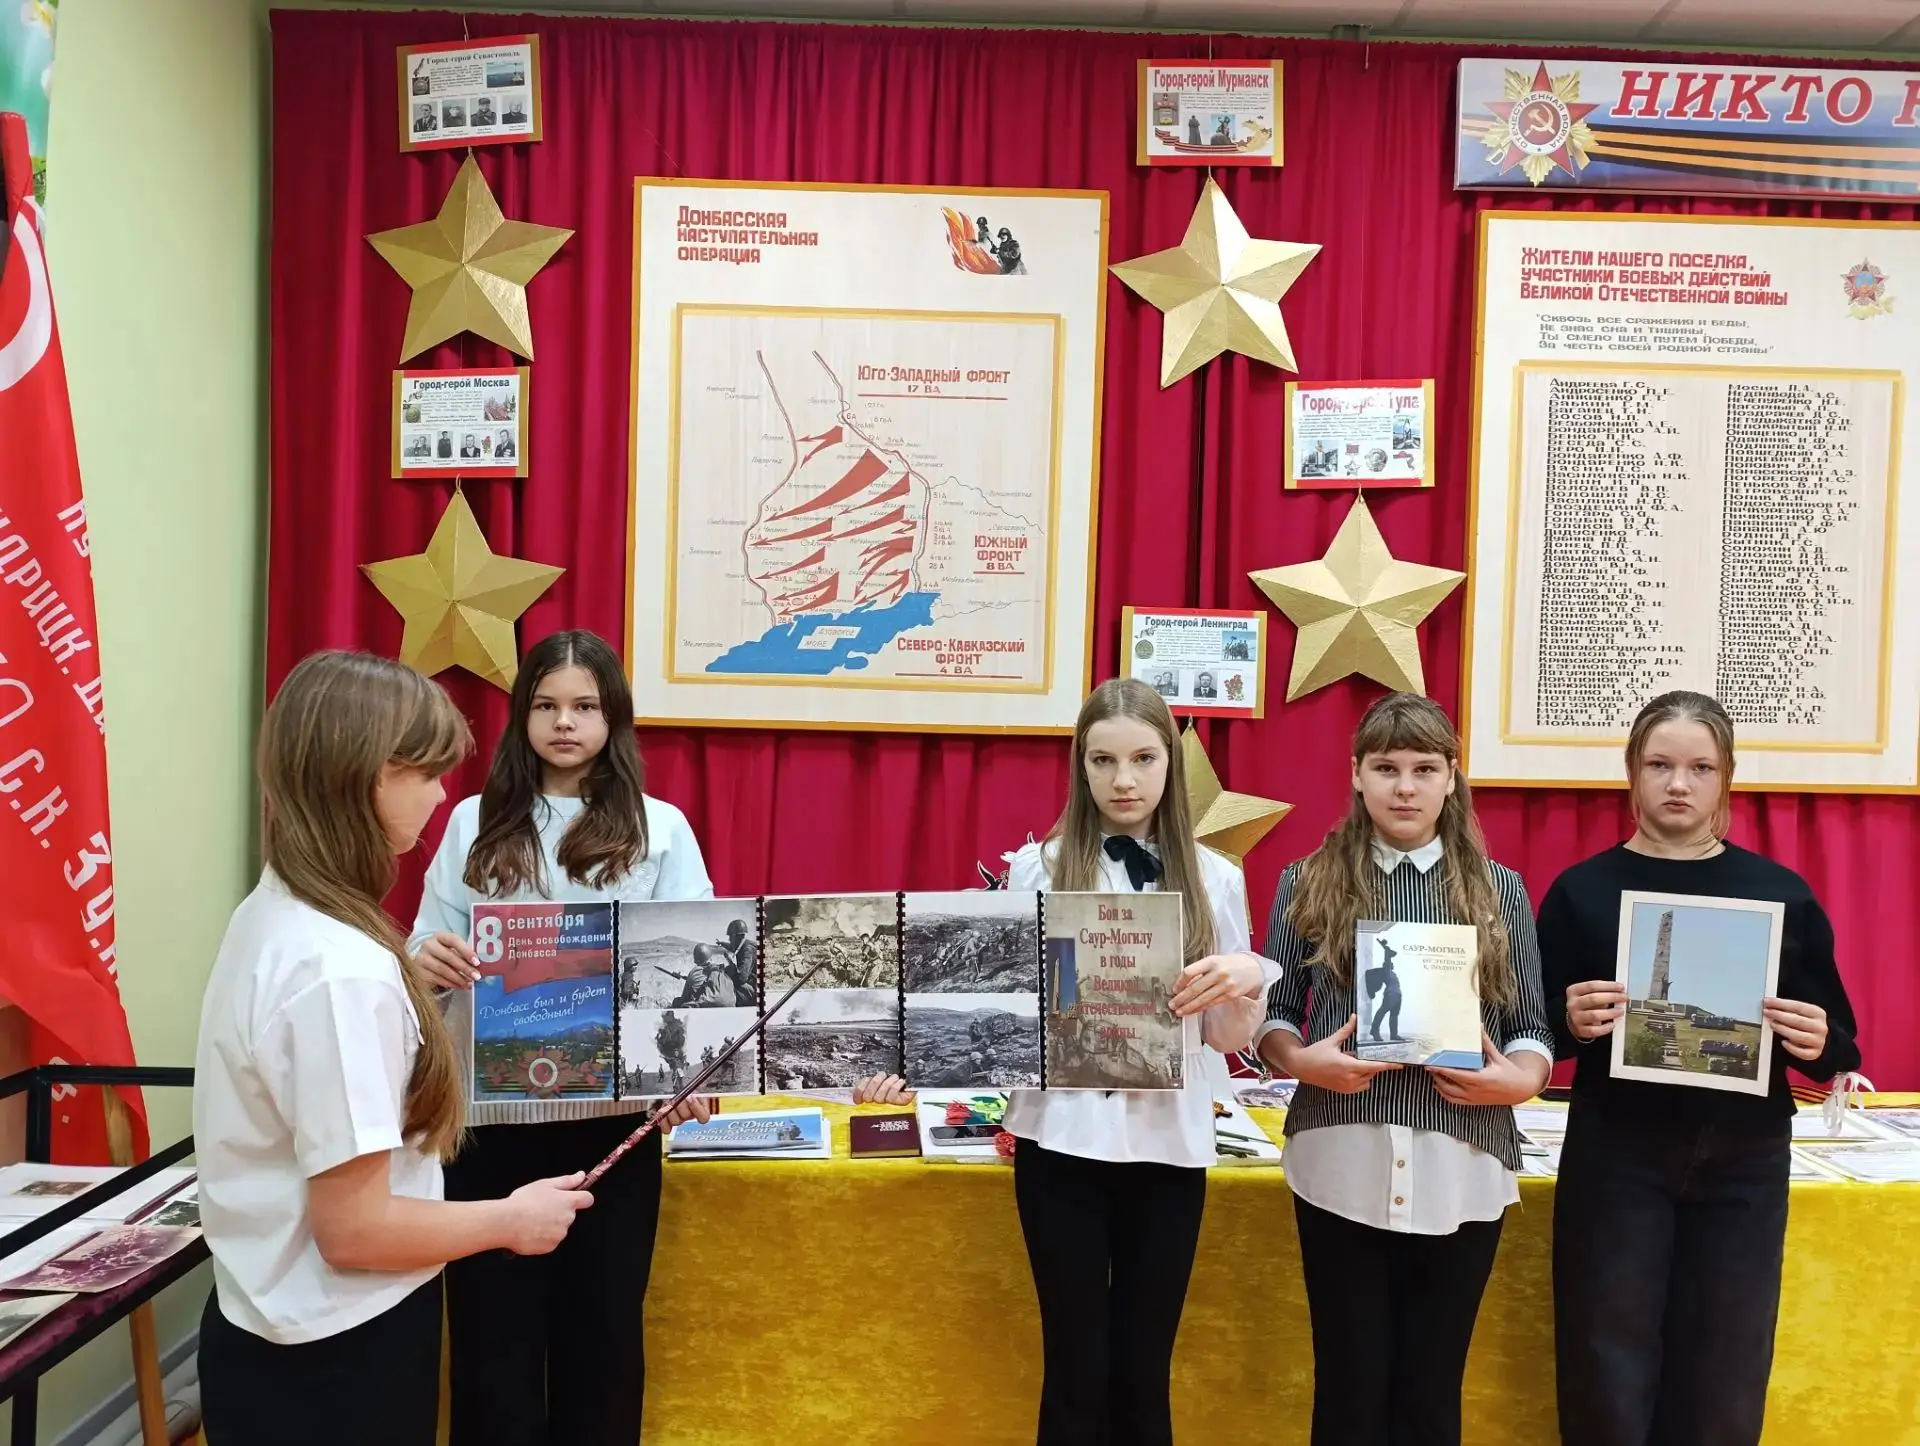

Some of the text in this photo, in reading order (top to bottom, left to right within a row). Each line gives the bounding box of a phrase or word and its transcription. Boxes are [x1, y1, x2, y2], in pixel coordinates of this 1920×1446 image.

[1154, 69, 1268, 91] Город-герой Мурманск
[1610, 70, 1873, 126] НИКТО
[414, 378, 510, 390] Город-герой Москва
[908, 384, 918, 393] 17
[974, 534, 1028, 549] ЮЖНЫЙ
[977, 550, 1022, 562] ФРОНТ
[1145, 616, 1248, 630] Город-герой Ленинград
[507, 913, 584, 930] сентября
[1122, 908, 1134, 921] за
[476, 916, 504, 964] 8
[508, 932, 612, 948] День освобождения
[1080, 928, 1153, 950] Саур-Могилу
[508, 948, 557, 960] Донбасса
[1402, 944, 1466, 954] САУР-МОГИЛА
[1100, 955, 1136, 970] в годы
[1093, 976, 1140, 993] Великой
[479, 985, 606, 1020] Донбасс был и будет
[513, 1002, 576, 1026] свободным!
